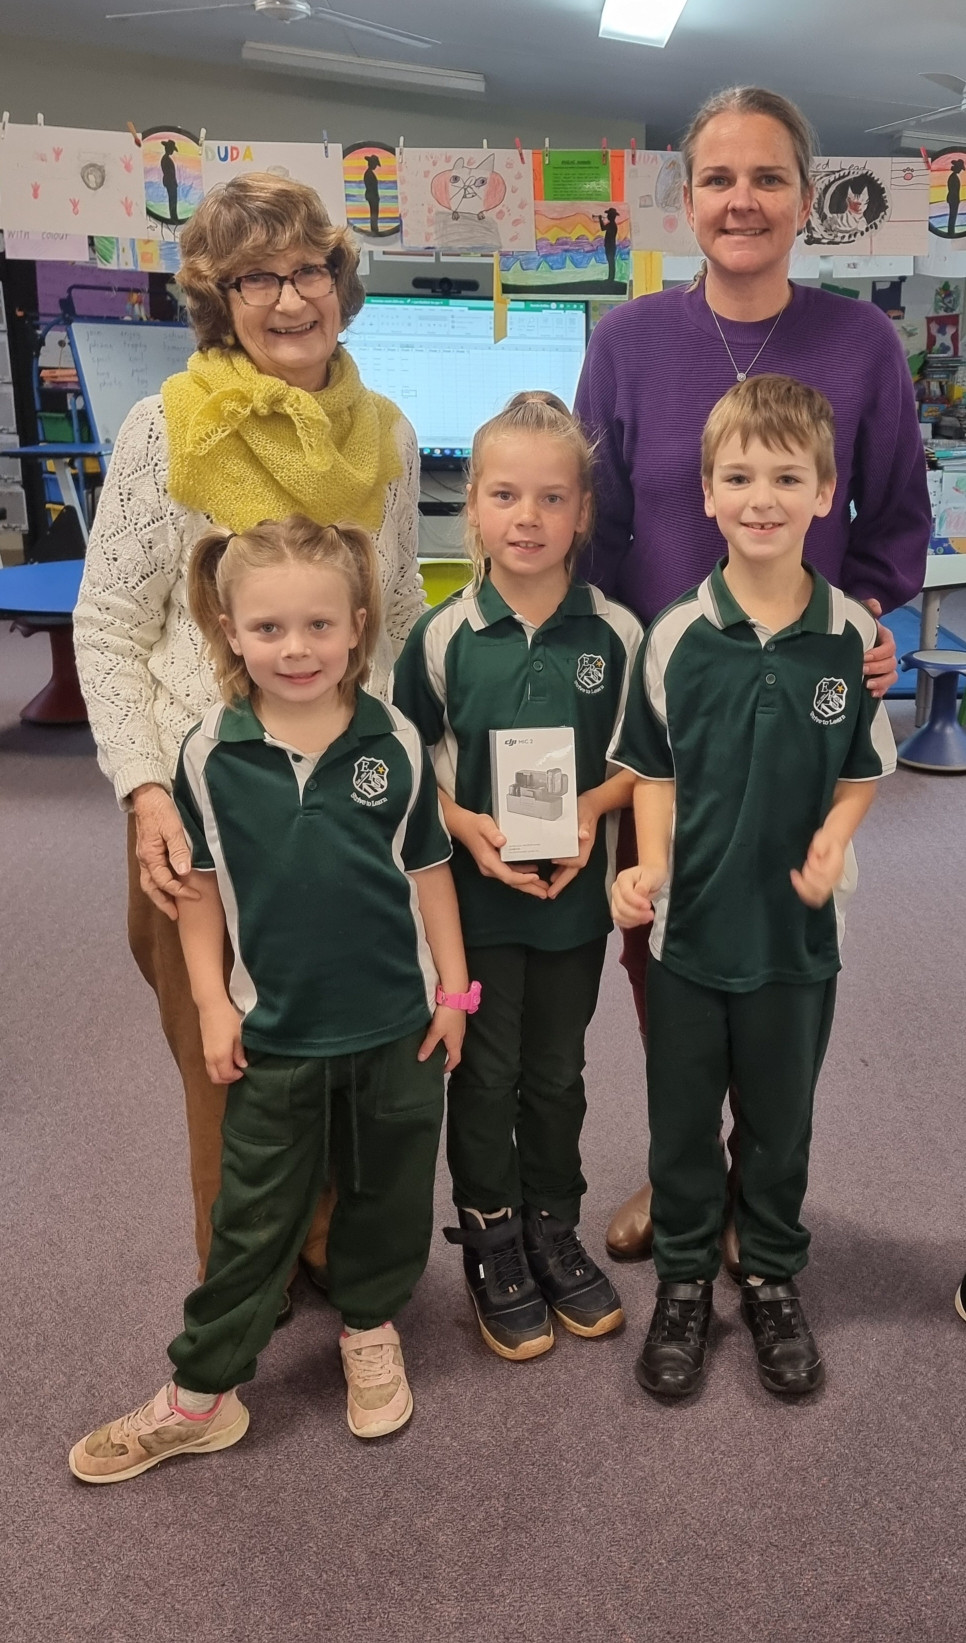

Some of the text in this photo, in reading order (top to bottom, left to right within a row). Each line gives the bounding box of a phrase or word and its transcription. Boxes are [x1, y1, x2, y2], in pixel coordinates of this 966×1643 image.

[839, 160, 868, 170] Lead
[583, 657, 590, 666] E
[821, 682, 830, 692] E
[360, 761, 370, 772] E
